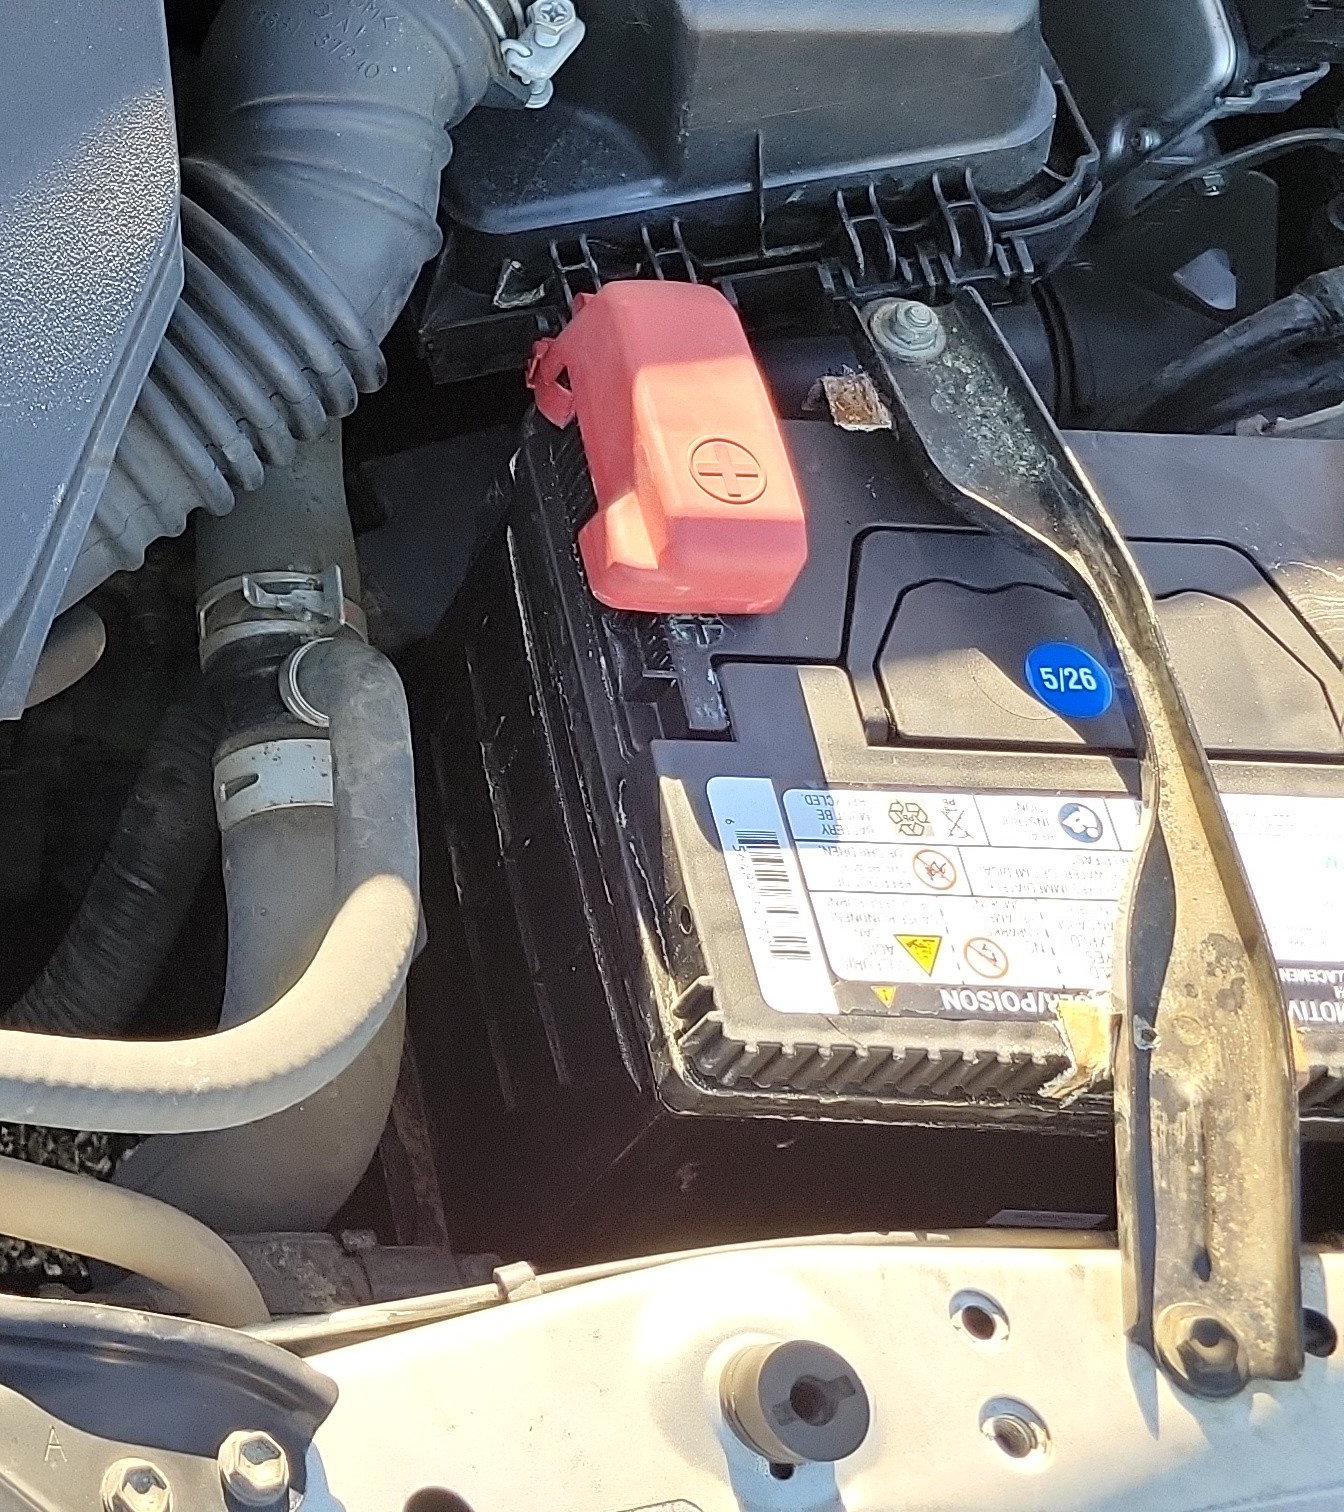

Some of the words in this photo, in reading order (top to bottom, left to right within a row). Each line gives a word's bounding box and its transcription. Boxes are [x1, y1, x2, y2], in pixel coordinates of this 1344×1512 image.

[1039, 664, 1096, 693] 5/26
[815, 808, 833, 821] BE
[902, 814, 915, 822] Pb
[821, 823, 874, 836] BAERY
[43, 1425, 69, 1463] A
